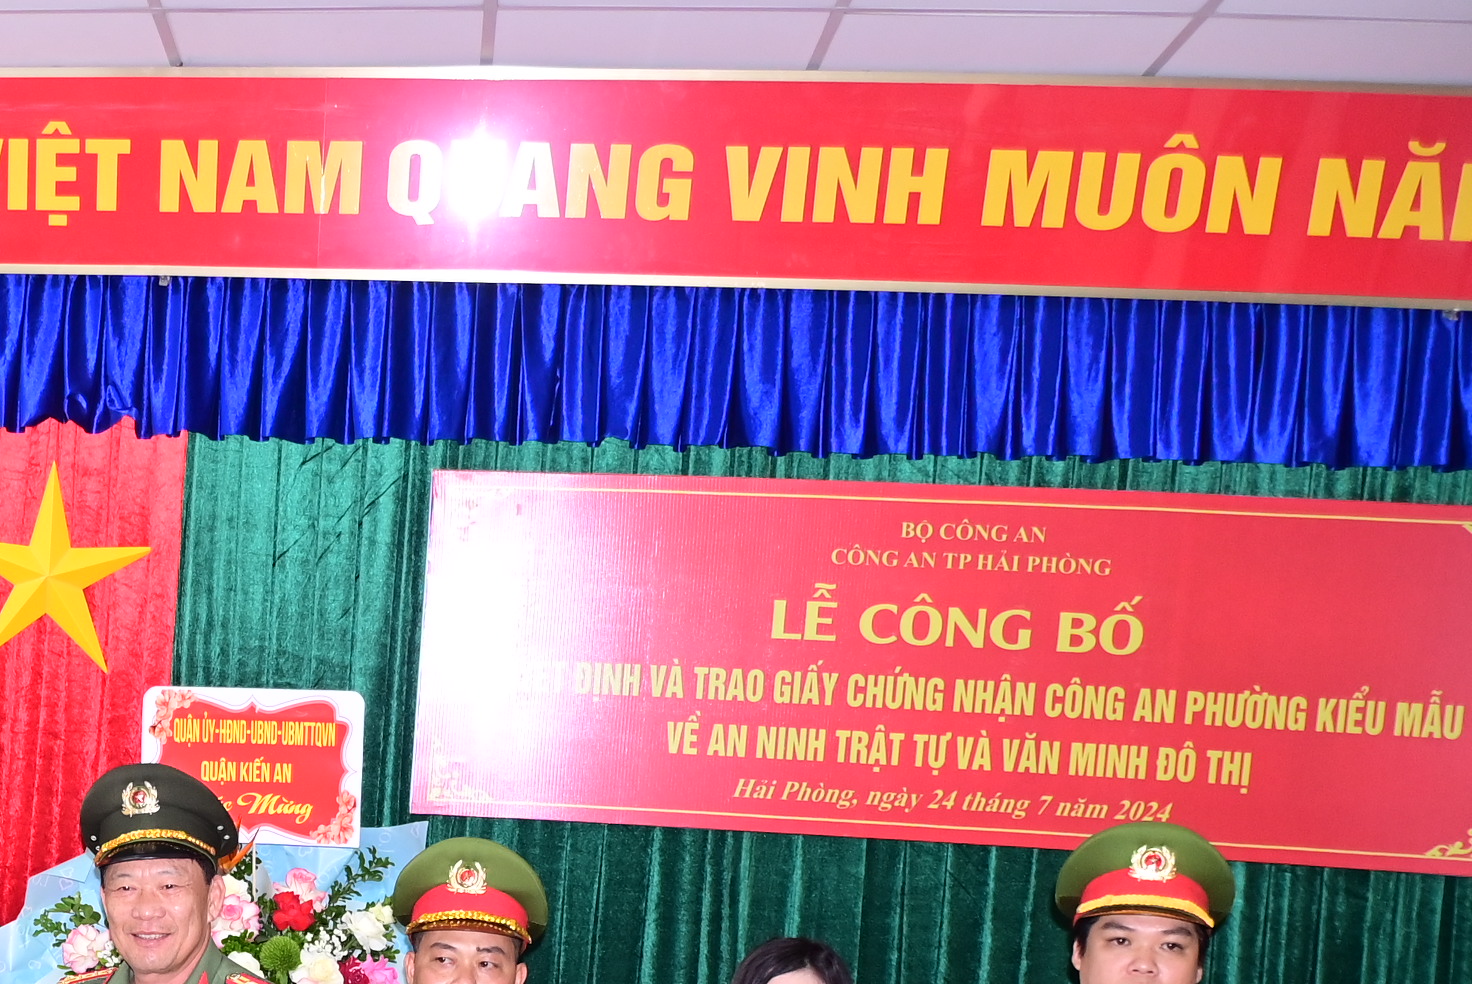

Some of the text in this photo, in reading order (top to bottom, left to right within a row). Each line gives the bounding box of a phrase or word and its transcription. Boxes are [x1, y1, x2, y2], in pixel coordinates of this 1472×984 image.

[159, 139, 363, 215] NAM
[387, 139, 695, 225] QANG
[725, 145, 950, 225] VINH
[981, 133, 1283, 236] MUÔN
[900, 519, 1048, 543] BỘ CÔNG AN
[830, 544, 1113, 577] CÔNG AN TP HẢI PHÒNG
[770, 582, 1146, 656] LỄ CÔNG BỐ
[576, 662, 642, 703] ĐỊNH
[650, 658, 685, 699] VÀ
[694, 666, 766, 702] TRAO
[773, 660, 840, 706] GIẤY
[846, 666, 946, 713] CHỨNG
[953, 673, 1037, 723] NHẬN
[1044, 677, 1126, 721] CÔNG
[1132, 687, 1178, 724] AN
[1184, 685, 1309, 732] PHƯỜNG
[1315, 685, 1387, 736] KIỂU
[1393, 689, 1466, 740] MẪU
[173, 713, 200, 747] QUẬN
[200, 756, 292, 786] QUẬN KIẾN AN
[666, 710, 1253, 795] VỀ AN NINH TRẬT TỰ VÀ VĂN MINH ĐÔ THỊ
[236, 792, 314, 825] Mừng
[733, 778, 1175, 823] Hải Phòng, ngày 24 tháng 7 năm 2024
